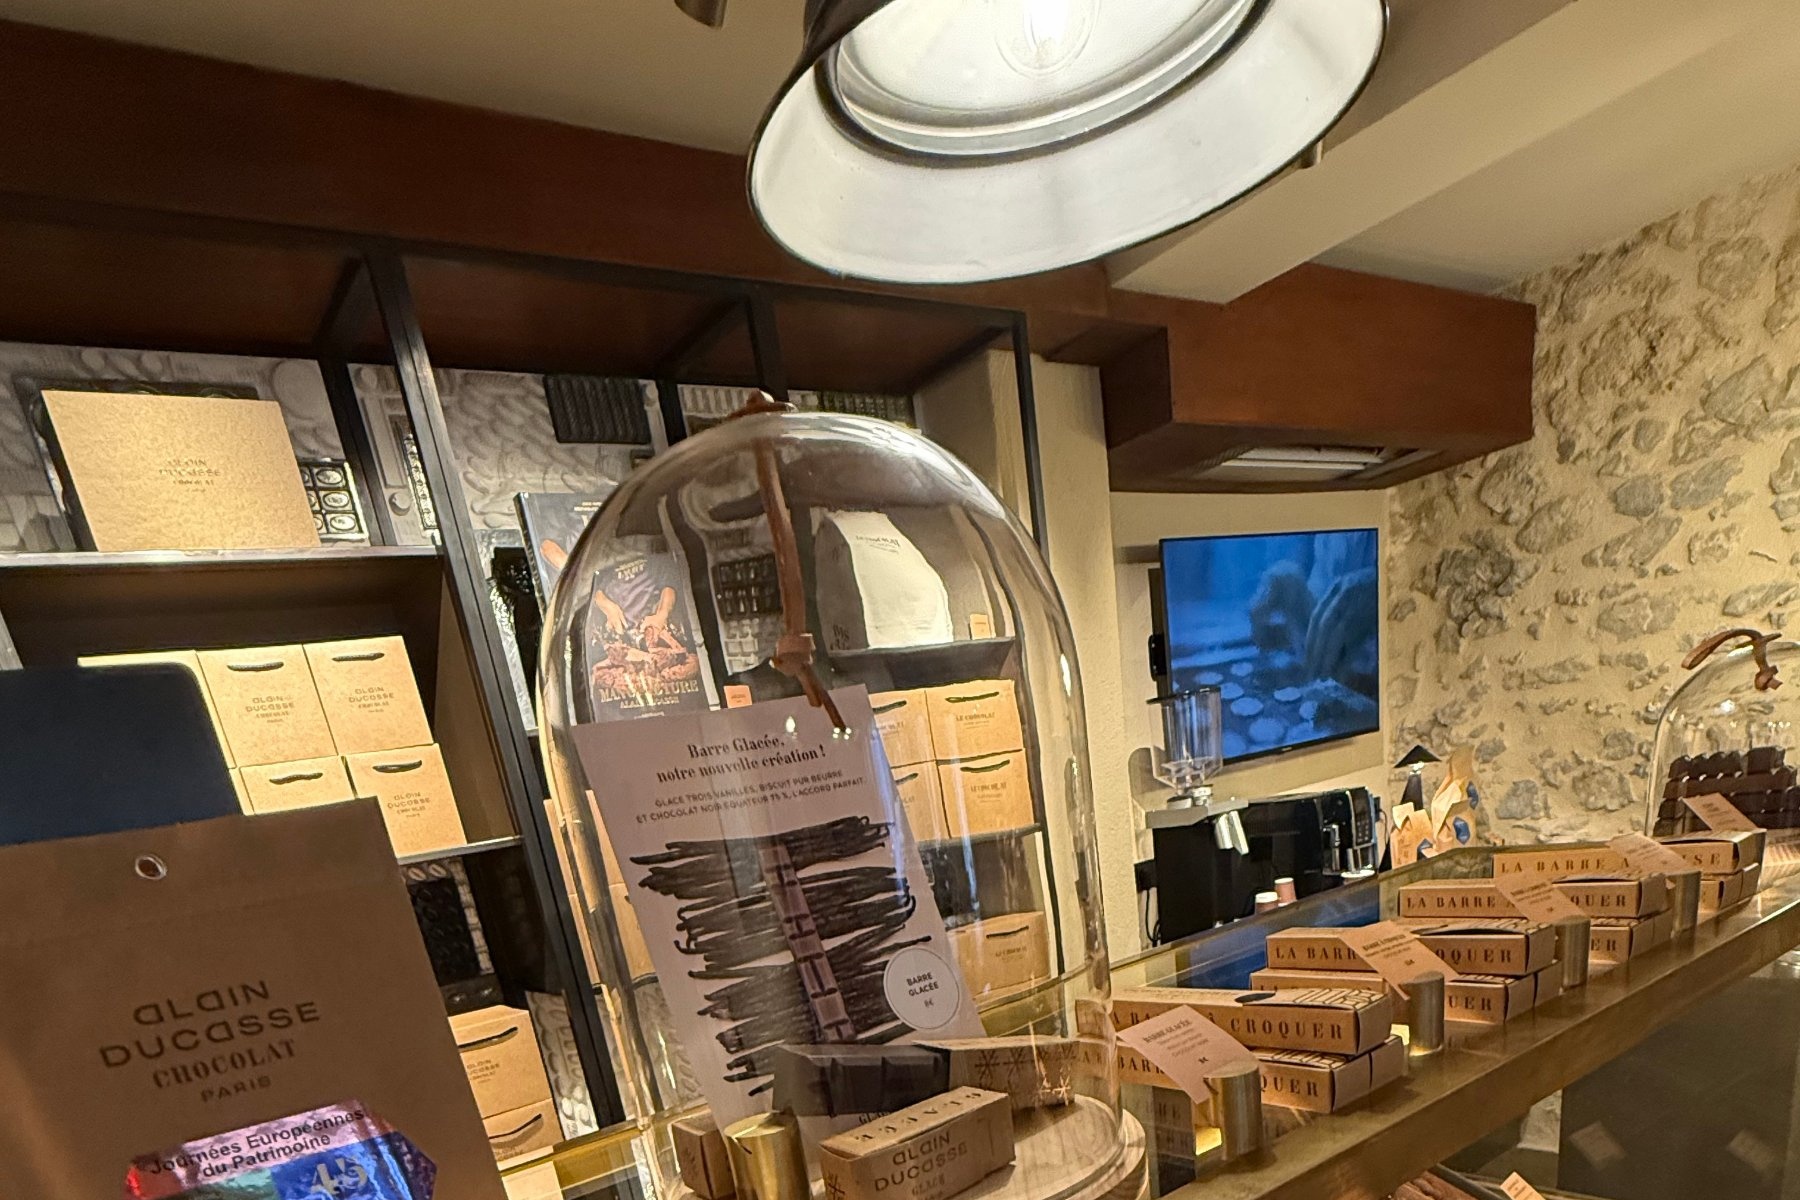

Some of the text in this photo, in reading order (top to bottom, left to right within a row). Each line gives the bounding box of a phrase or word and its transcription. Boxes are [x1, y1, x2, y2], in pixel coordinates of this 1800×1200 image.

[686, 734, 785, 759] Barre Glacée,
[656, 767, 696, 784] notre
[699, 757, 759, 777] nouvelle
[650, 806, 698, 822] CHOCOLAT
[1502, 861, 1523, 874] LA
[1536, 858, 1606, 872] BARRE
[1406, 896, 1427, 909] LA
[1436, 895, 1497, 909] BARRE
[1275, 946, 1513, 964] LA BARR OQUER
[905, 972, 933, 987] BARRE
[908, 981, 939, 997] GLACÉE
[1230, 1017, 1343, 1040] CROQUER
[152, 1038, 296, 1089] CHOCOLAT
[200, 1074, 272, 1103] PARIS
[150, 1107, 365, 1175] Journées Européennes
[202, 1132, 331, 1178] du Patrimoine
